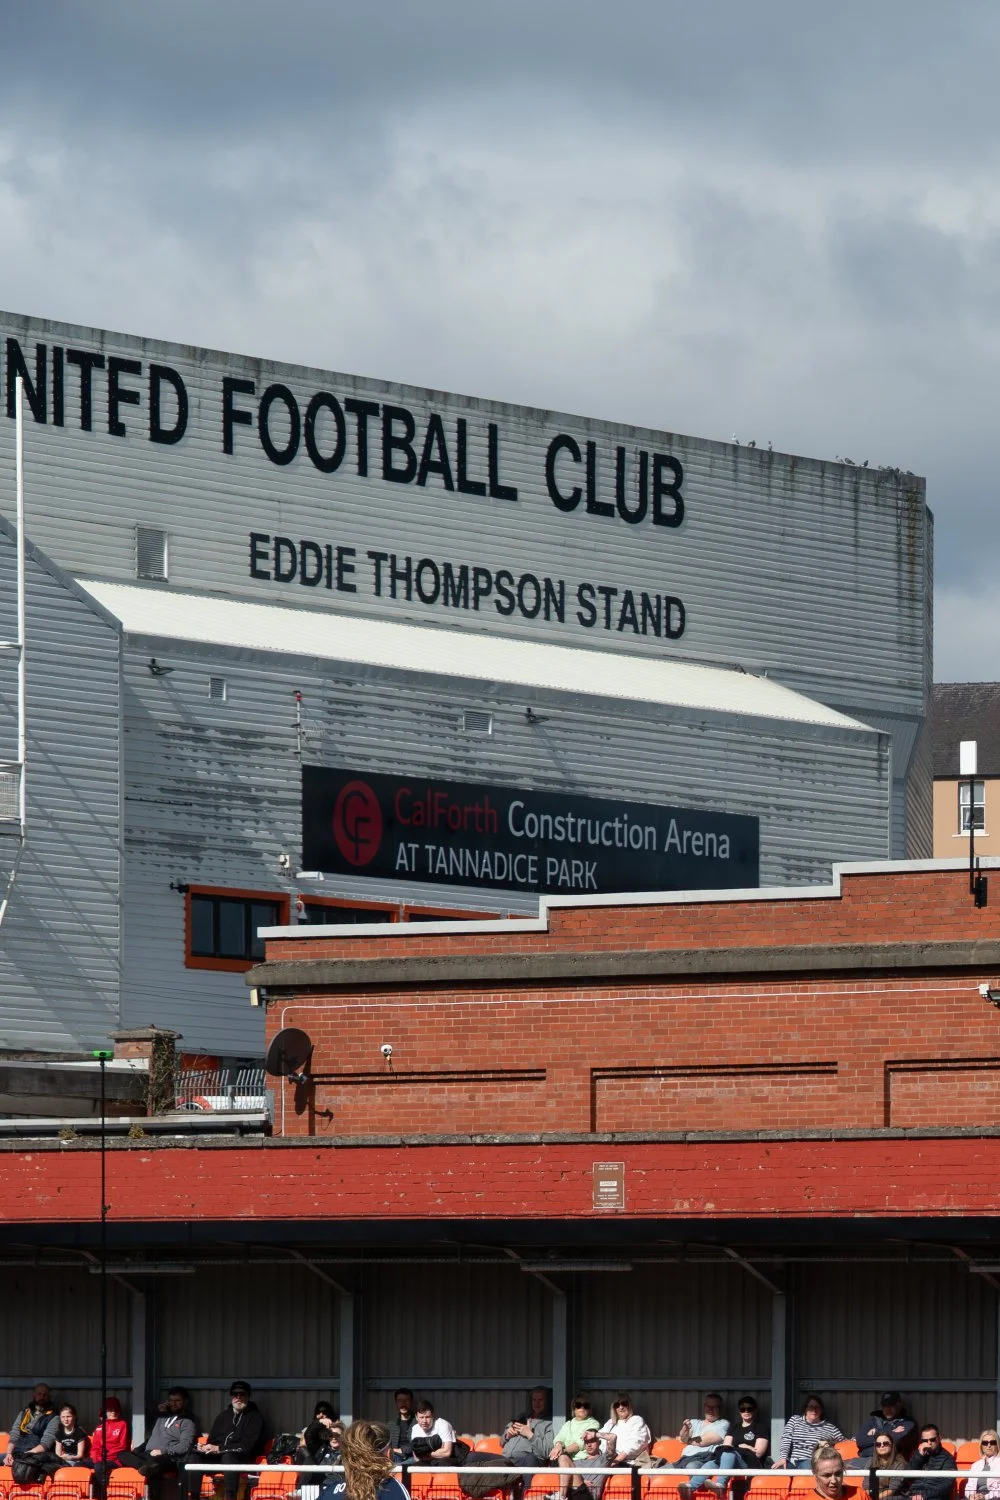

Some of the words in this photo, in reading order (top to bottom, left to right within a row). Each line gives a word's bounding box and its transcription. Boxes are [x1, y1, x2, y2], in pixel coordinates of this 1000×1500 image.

[6, 337, 189, 446] NITED
[222, 377, 518, 500] FOOTBALL
[545, 434, 686, 529] CLUB
[249, 532, 357, 593] EDDIE
[367, 550, 565, 624] THOMPSON
[577, 582, 686, 640] STAND
[394, 787, 498, 834] CalForth
[507, 800, 657, 851] Construction
[664, 818, 731, 859] Arena
[395, 842, 419, 872] AT
[425, 844, 539, 884] TANNADICE
[546, 857, 598, 890] PARK
